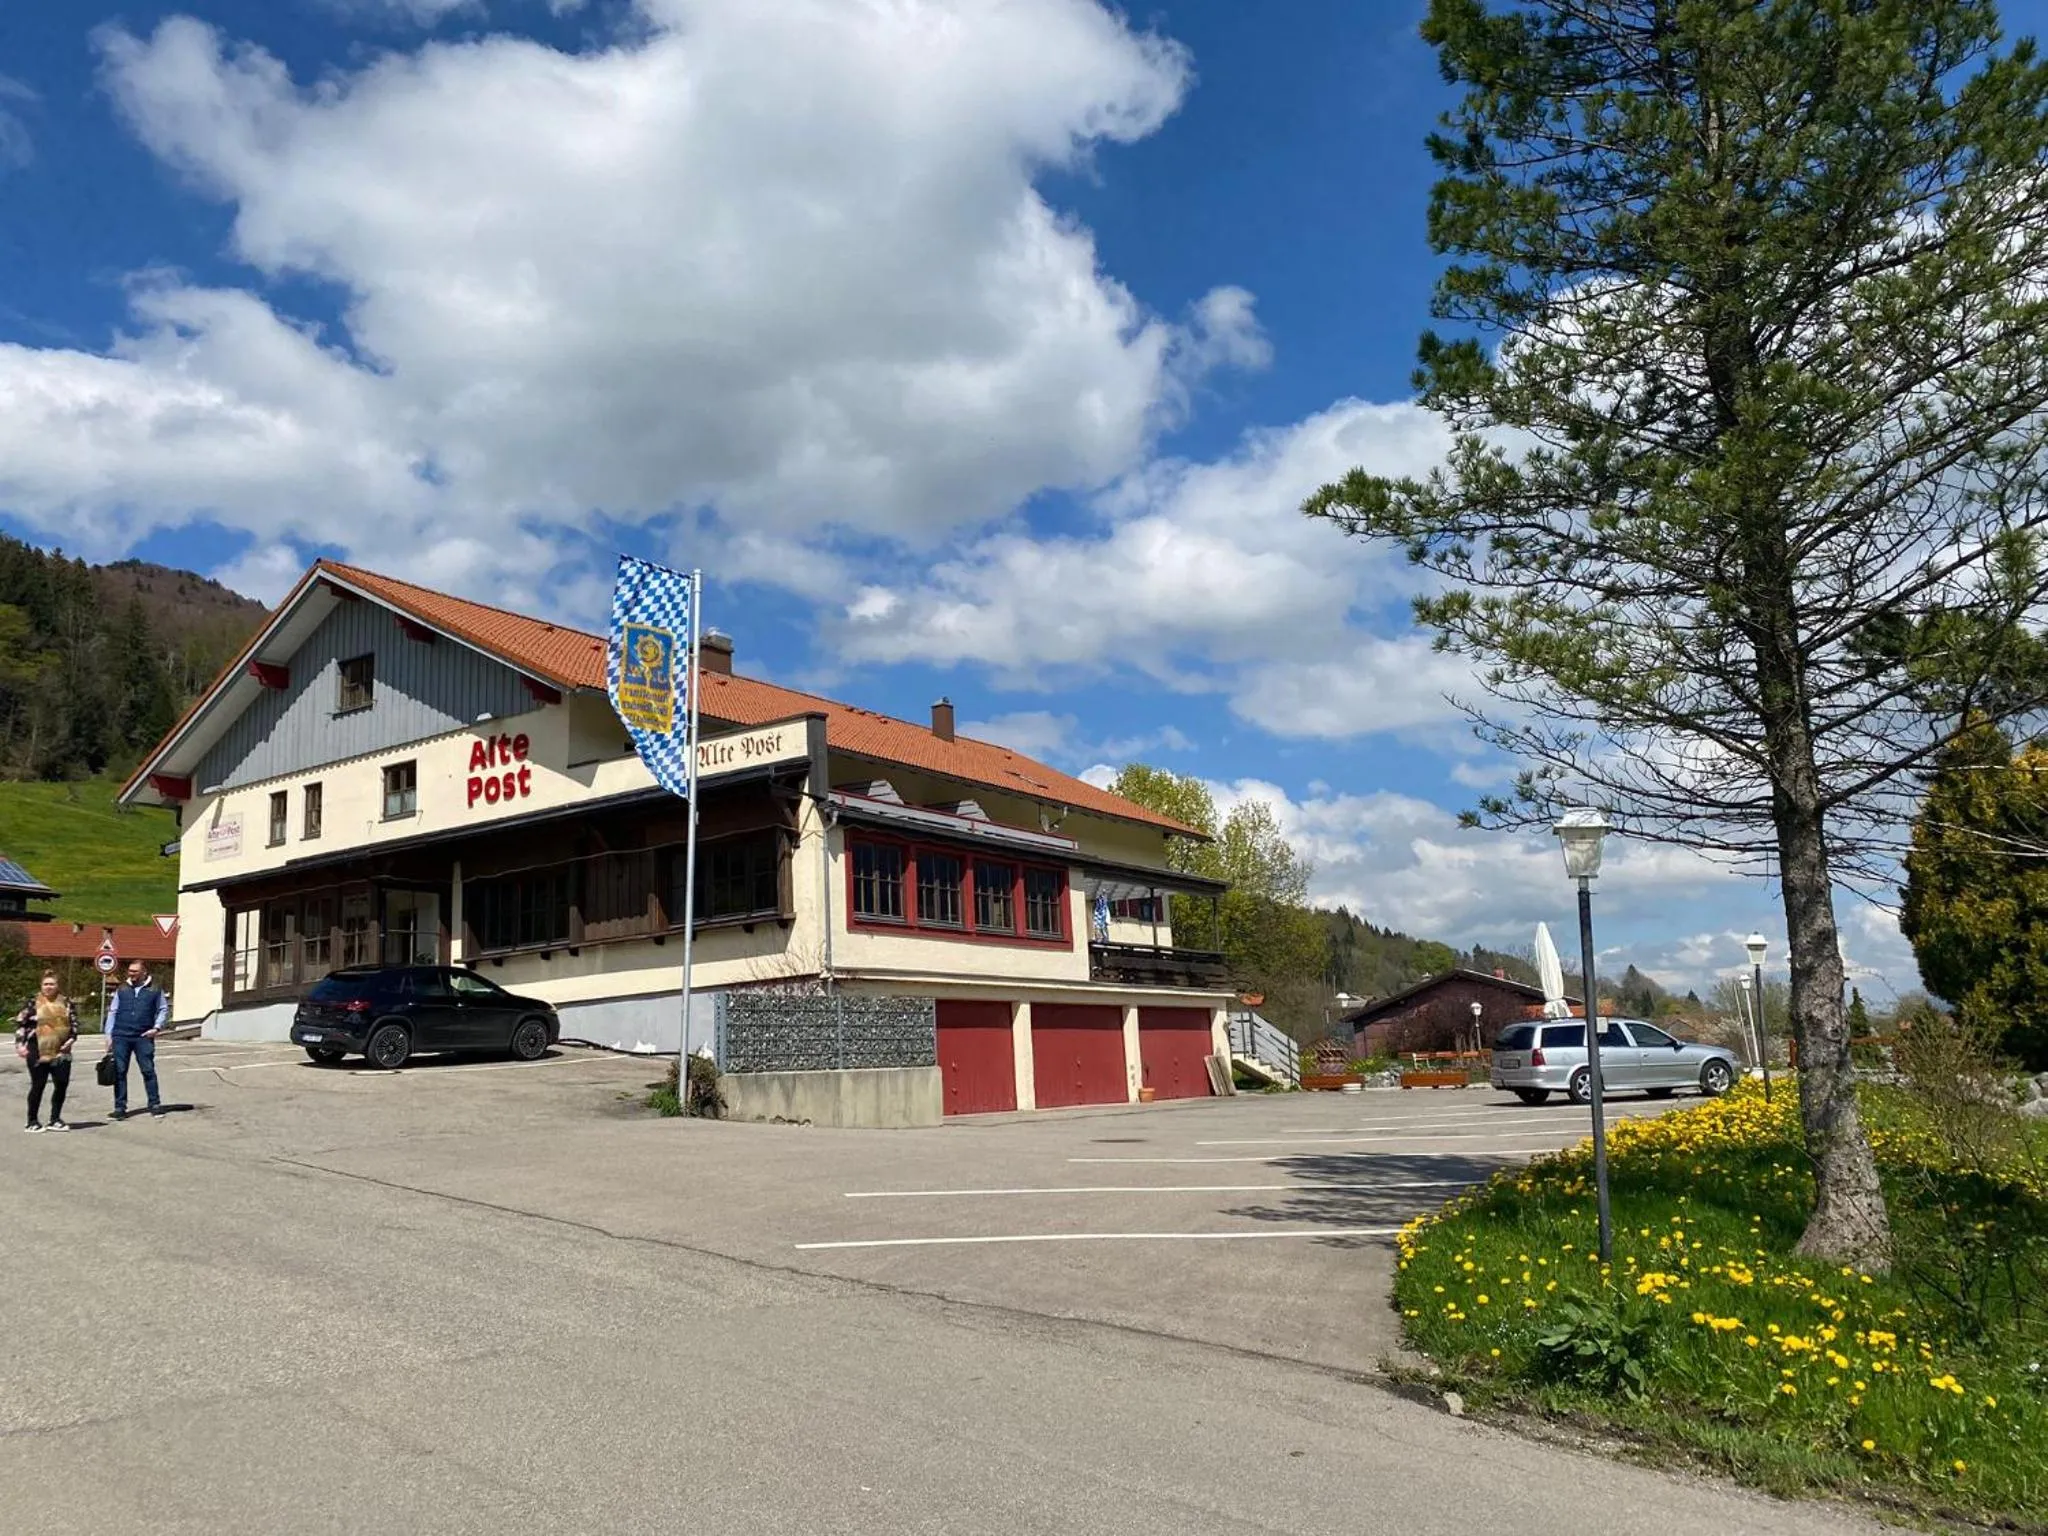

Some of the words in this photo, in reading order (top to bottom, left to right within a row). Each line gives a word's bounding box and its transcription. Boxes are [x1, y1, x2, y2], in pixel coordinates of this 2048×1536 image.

[469, 732, 530, 772] Alte
[697, 742, 734, 768] Alte
[740, 731, 782, 759] Post
[467, 764, 531, 809] Post
